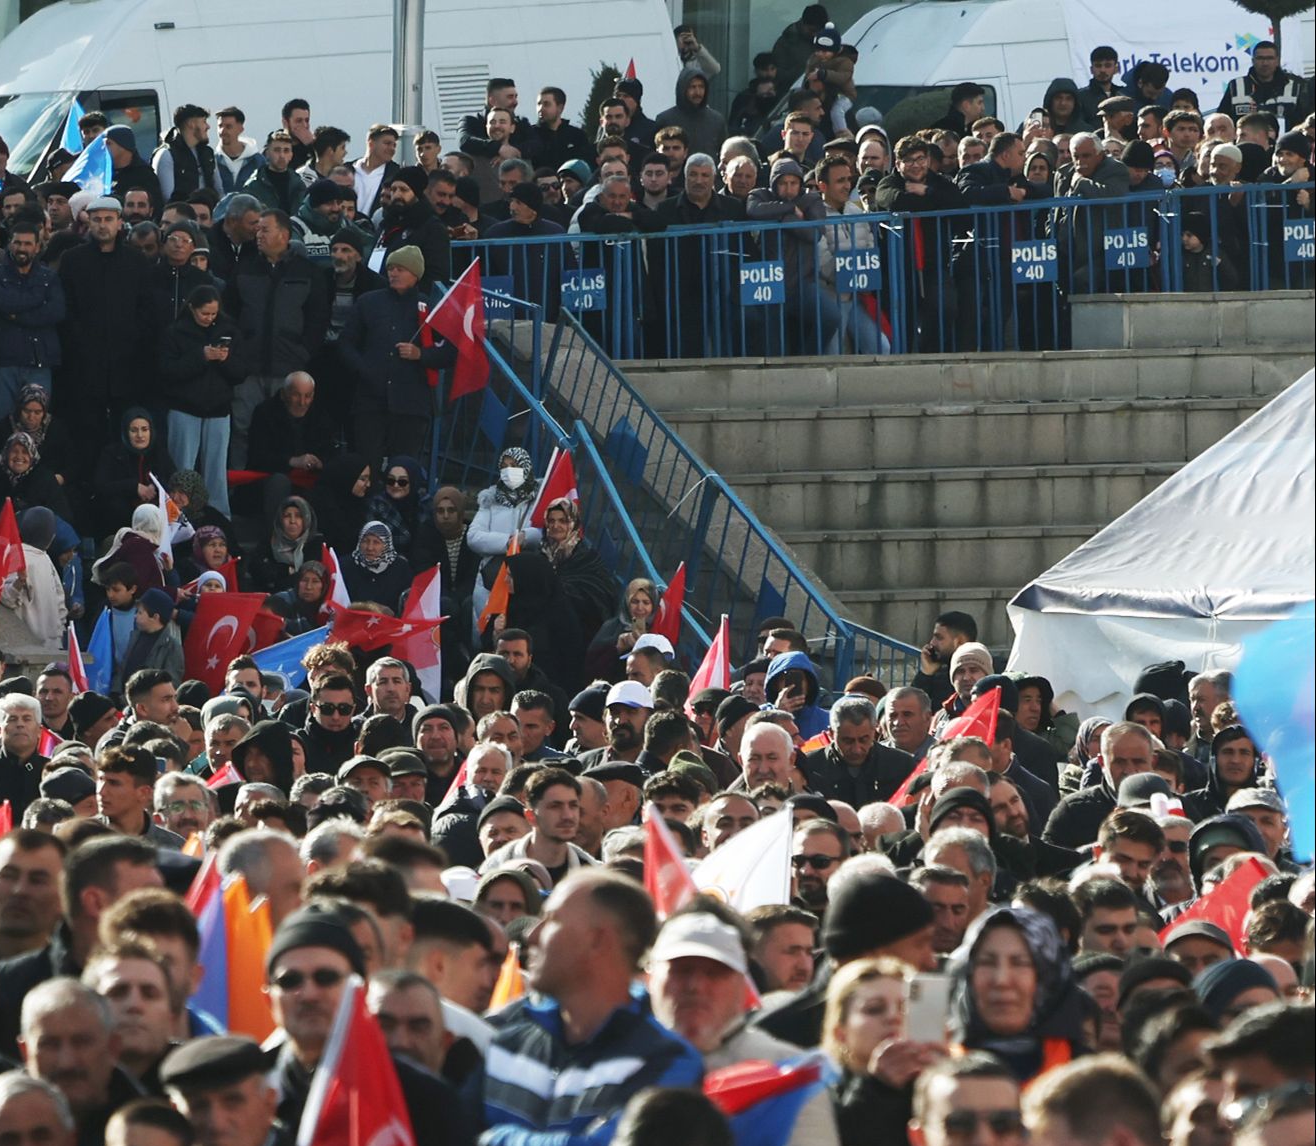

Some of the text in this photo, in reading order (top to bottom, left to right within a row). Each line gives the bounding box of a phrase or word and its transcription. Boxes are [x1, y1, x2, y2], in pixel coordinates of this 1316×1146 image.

[1149, 52, 1239, 73] Telekom
[1011, 242, 1057, 263] POLİS
[1296, 243, 1315, 258] 40
[1117, 252, 1136, 267] 40
[740, 263, 784, 284] POLİS
[1025, 265, 1044, 280] 40
[753, 286, 772, 301] 40
